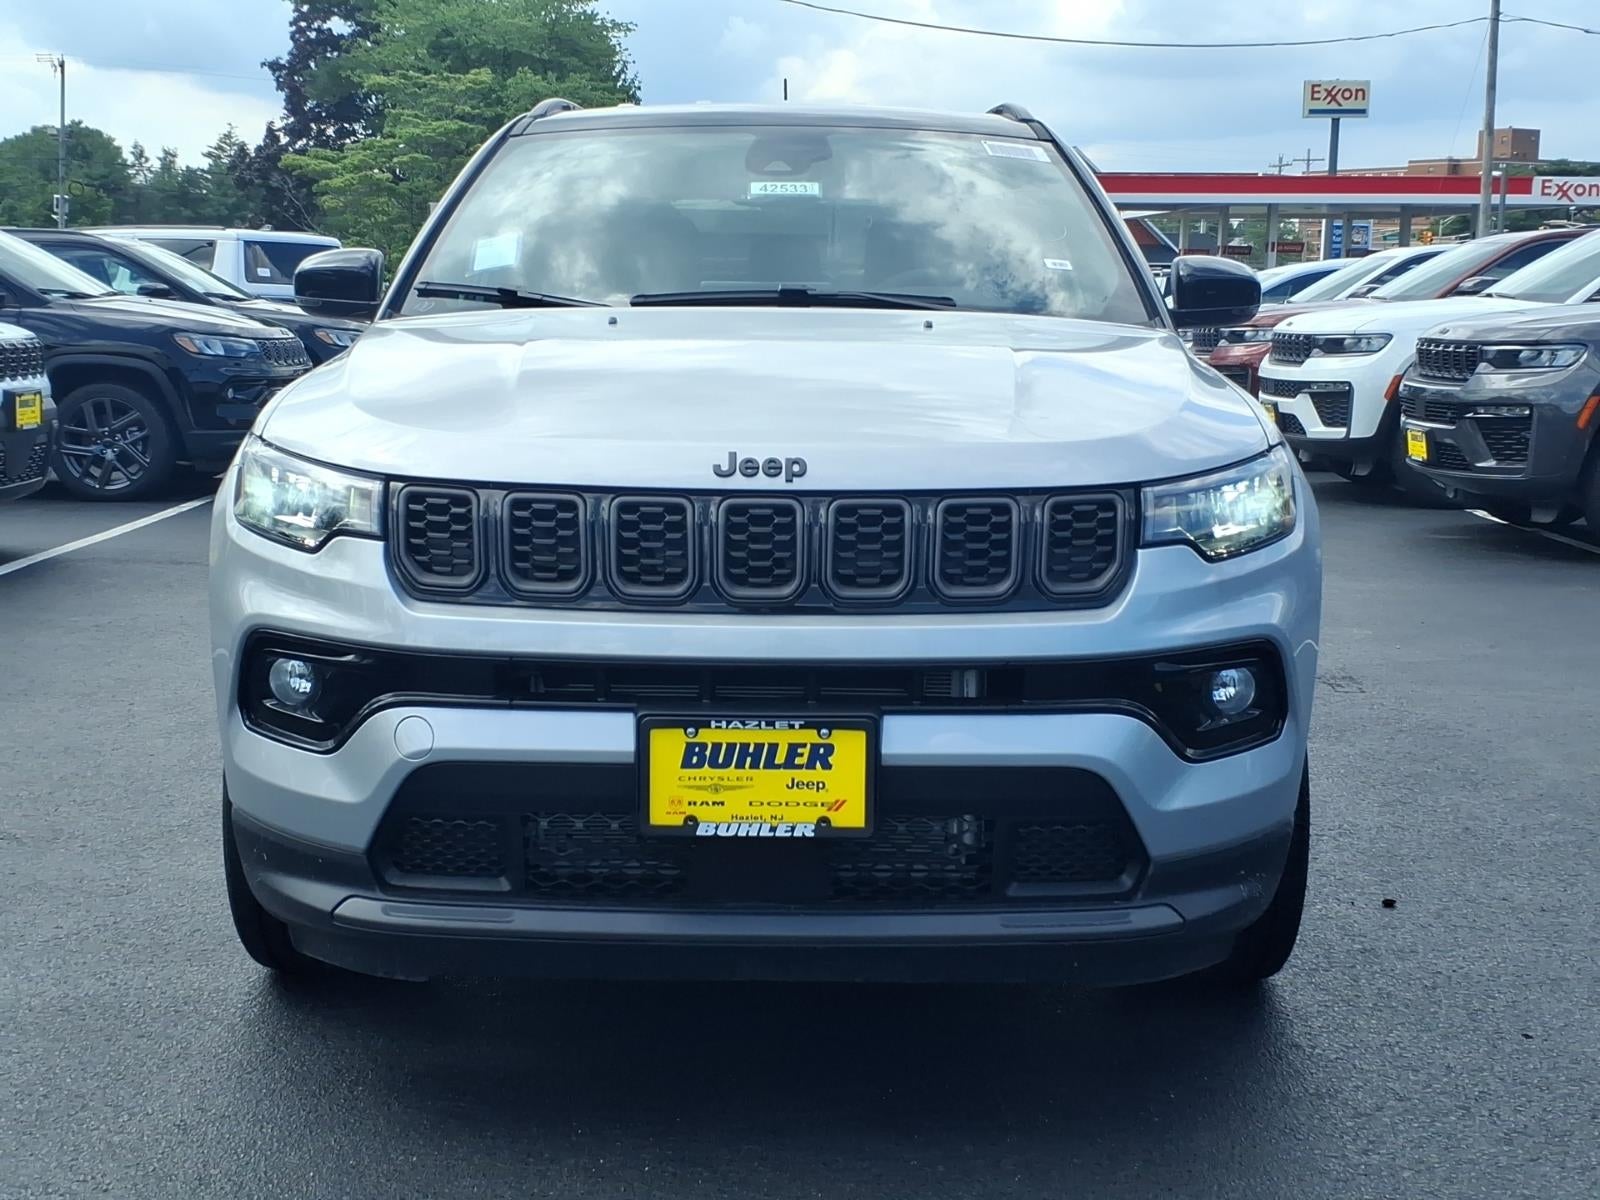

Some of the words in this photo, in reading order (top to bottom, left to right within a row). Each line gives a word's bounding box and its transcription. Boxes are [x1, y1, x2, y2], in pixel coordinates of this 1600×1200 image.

[1310, 84, 1366, 107] Exxon
[1541, 179, 1600, 203] Exxon
[712, 451, 807, 482] Jeep
[711, 720, 805, 729] HAZLET
[681, 742, 835, 769] BUHLER
[786, 777, 826, 792] Jeep
[731, 814, 767, 822] Hazlet,
[696, 823, 815, 837] BUHLER
